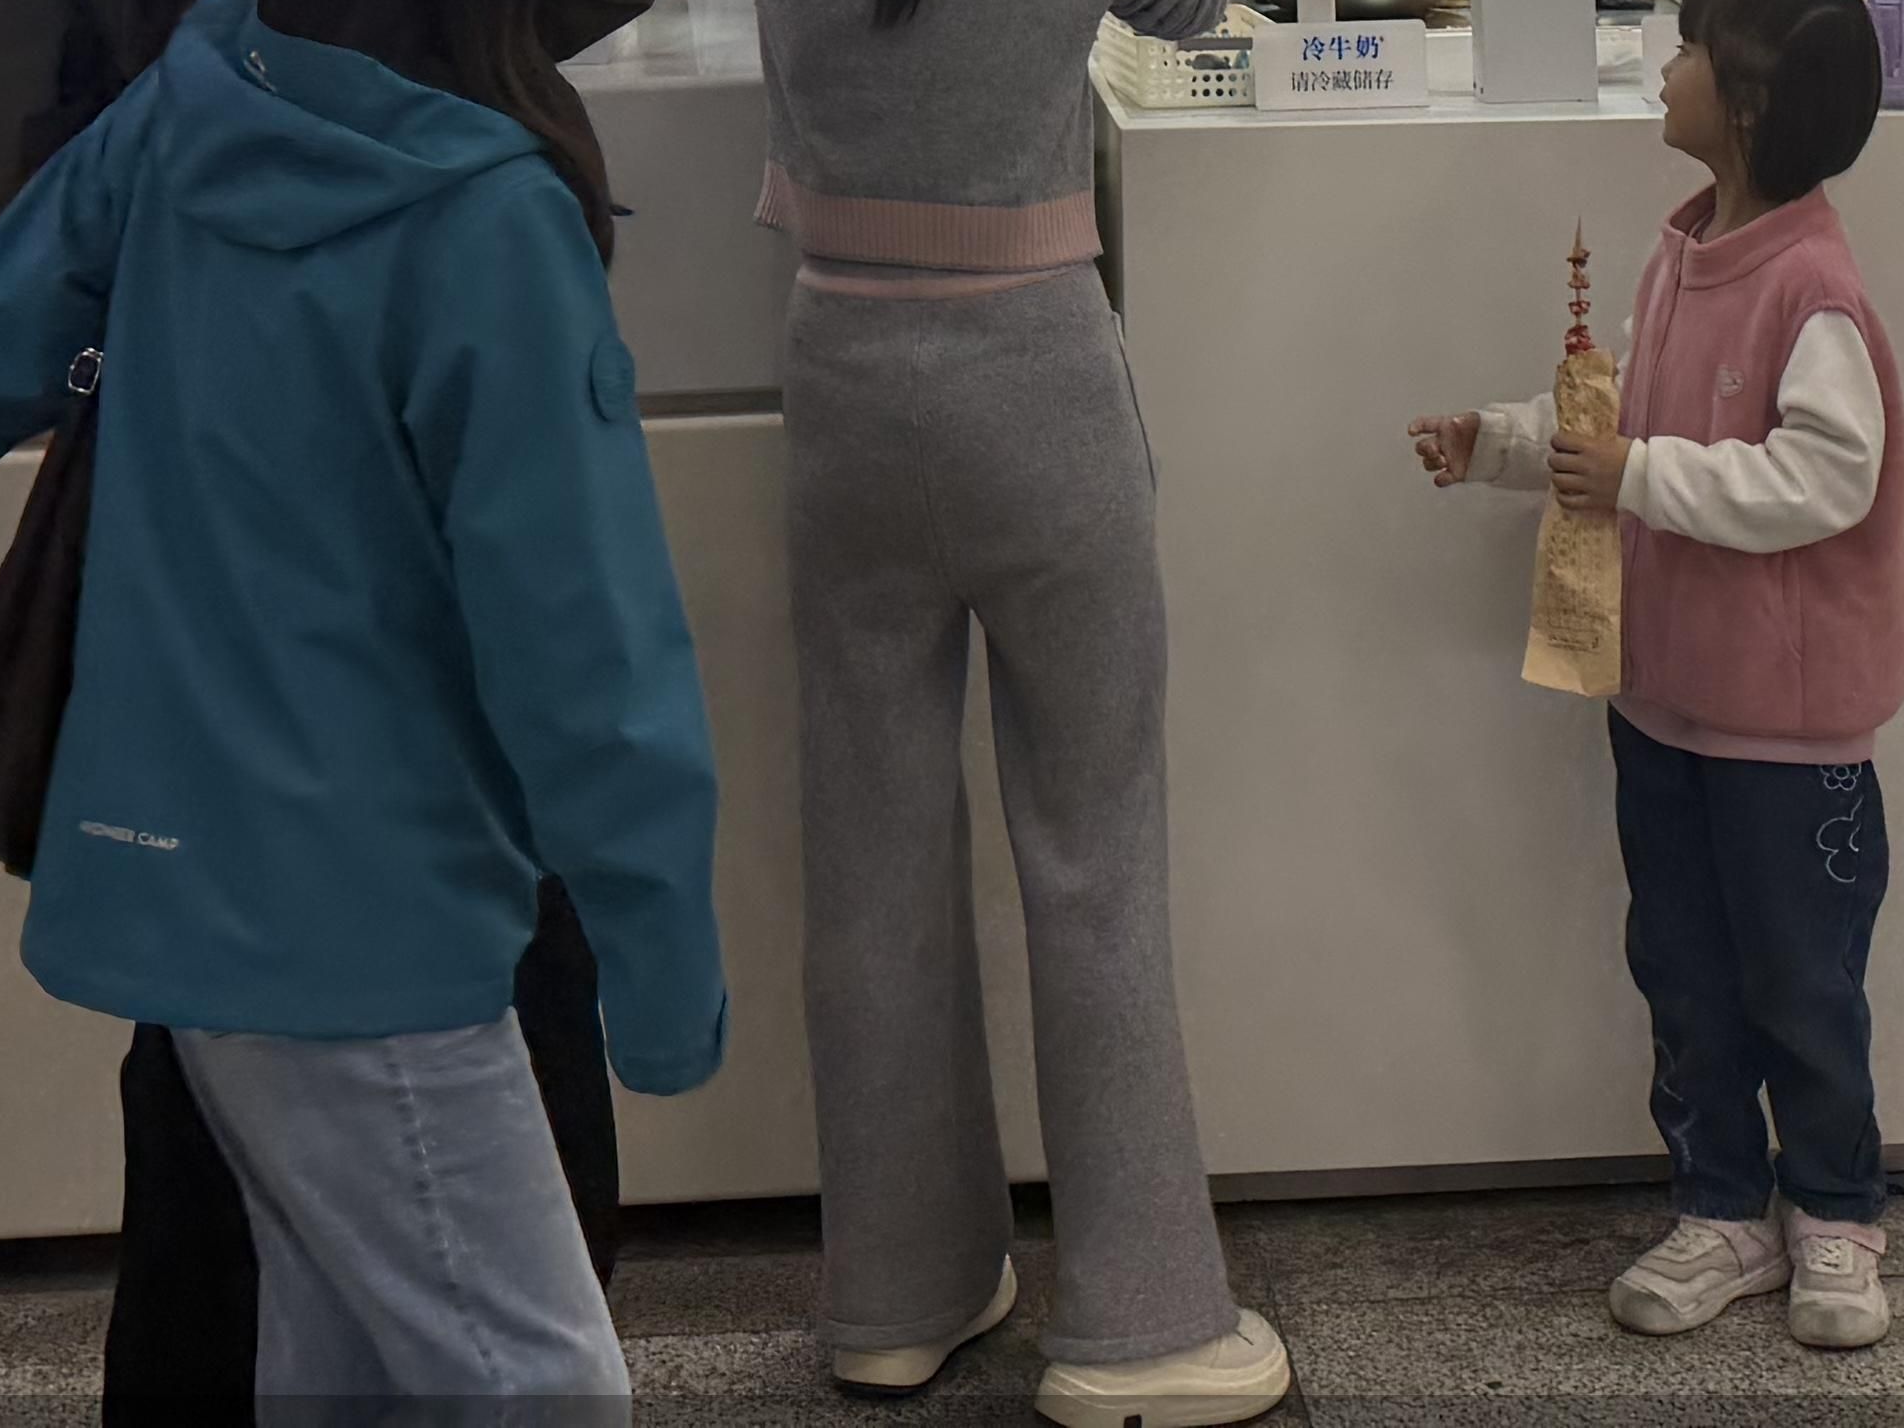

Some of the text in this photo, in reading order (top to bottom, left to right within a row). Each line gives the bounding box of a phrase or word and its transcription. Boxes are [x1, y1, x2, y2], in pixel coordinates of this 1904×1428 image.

[1303, 35, 1384, 61] 冷牛奶
[1291, 69, 1394, 92] 请冷藏储存
